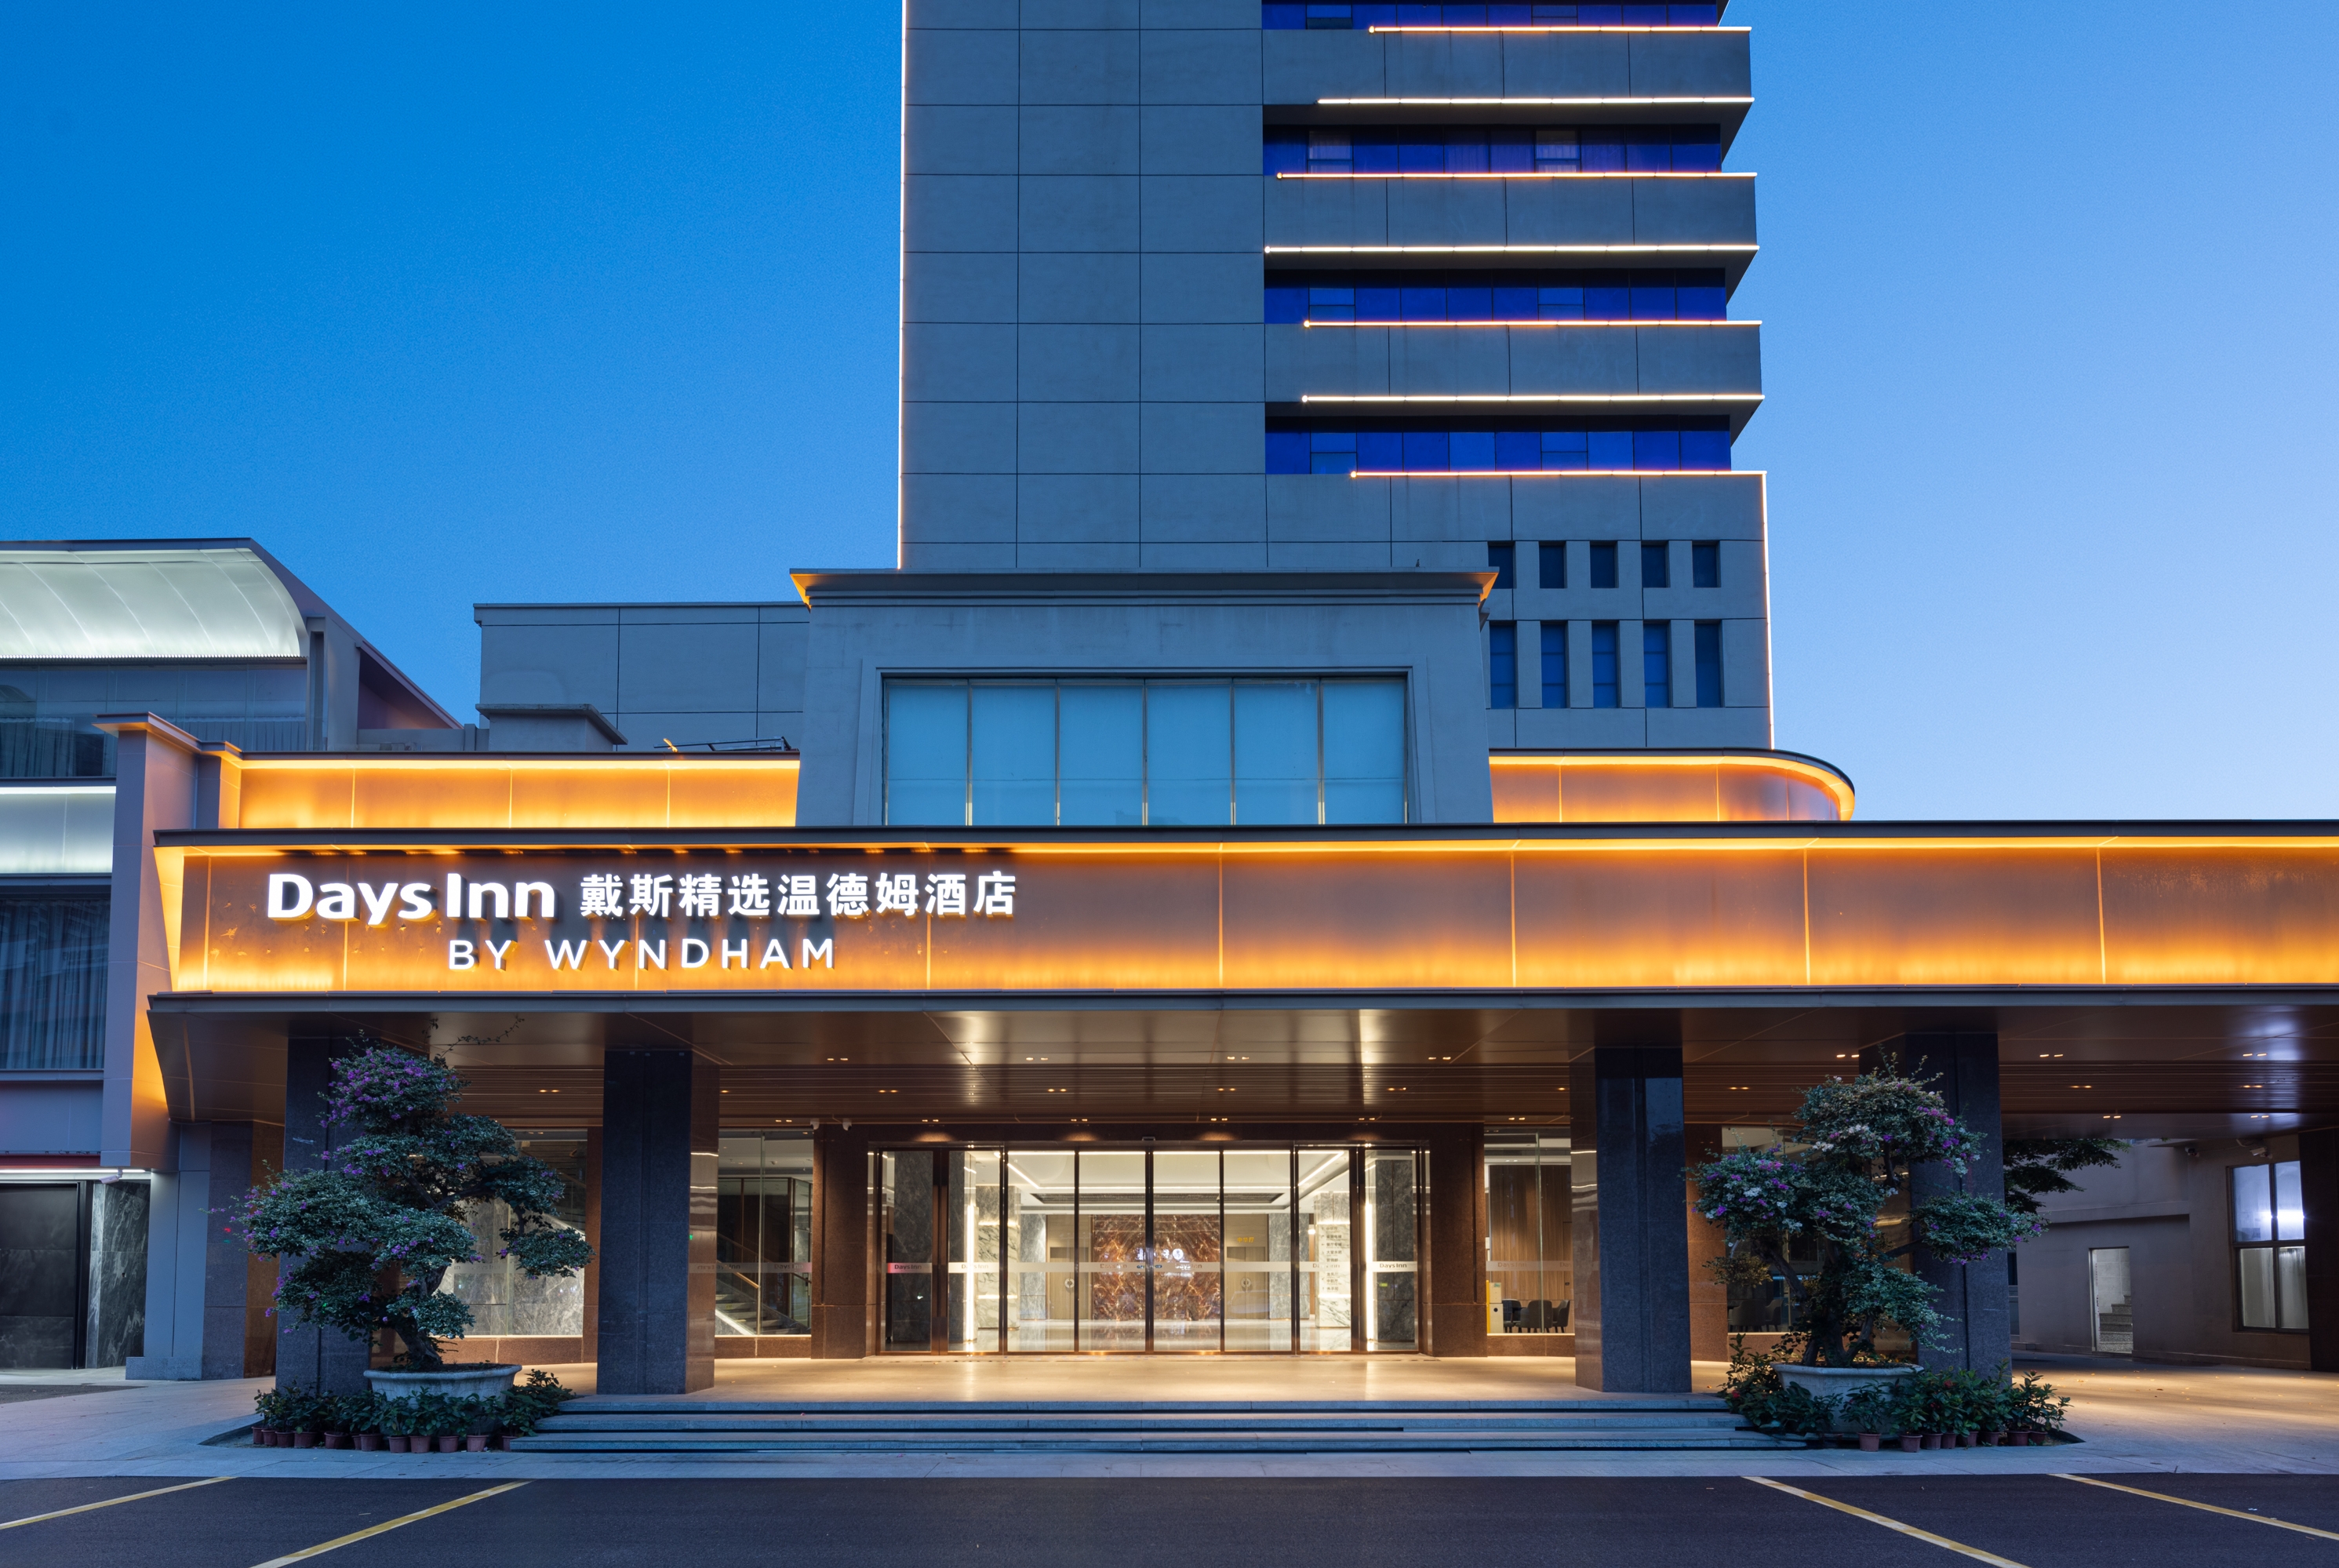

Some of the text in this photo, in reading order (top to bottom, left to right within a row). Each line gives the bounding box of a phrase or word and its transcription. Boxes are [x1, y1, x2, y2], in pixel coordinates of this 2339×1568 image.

[268, 872, 555, 926] Days Inn
[580, 871, 1016, 917] 戴斯精选温德姆酒店
[449, 938, 835, 970] BY WYNDHAM
